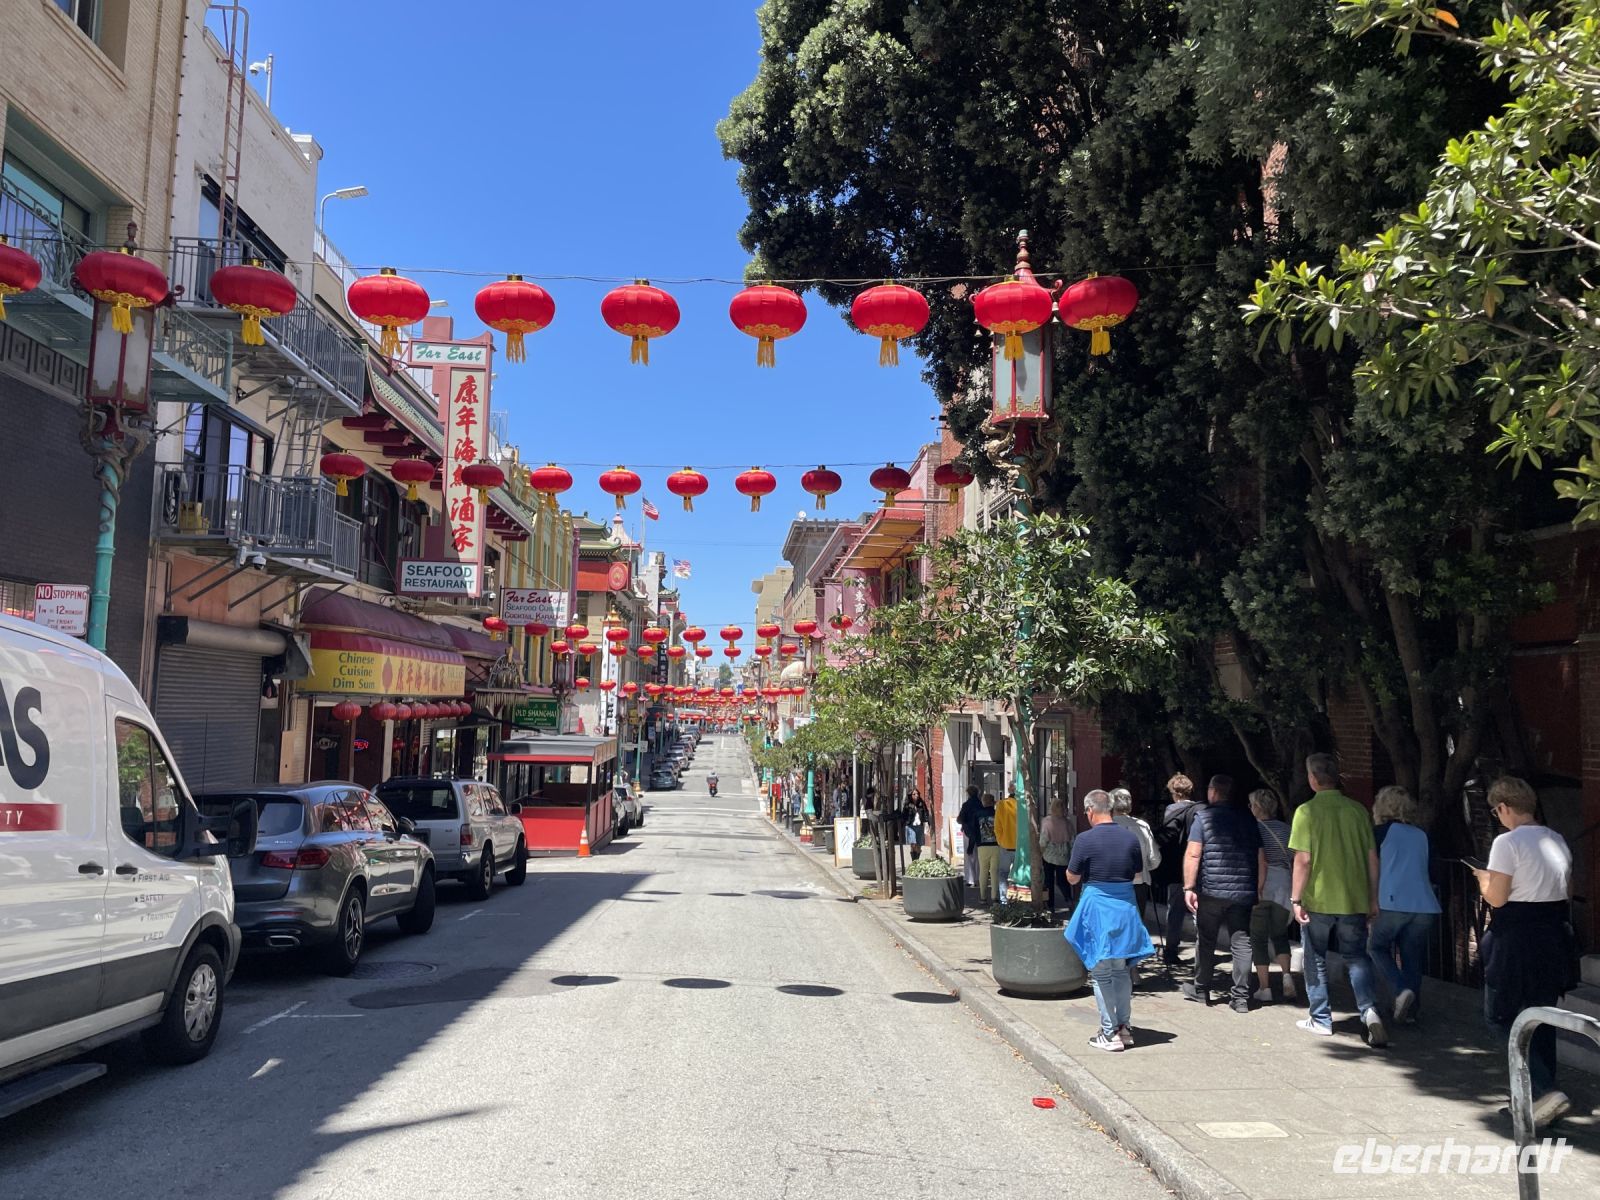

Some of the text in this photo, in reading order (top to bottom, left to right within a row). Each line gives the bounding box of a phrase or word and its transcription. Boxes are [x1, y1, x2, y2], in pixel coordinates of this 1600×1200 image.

[416, 343, 482, 361] Far East
[406, 564, 472, 578] SEAFOOD
[404, 577, 474, 589] RESTAURANT
[37, 585, 87, 600] NO STOPPING
[505, 590, 525, 603] Far
[526, 591, 553, 604] East
[506, 602, 565, 613] SEAFOOD CUISINE
[338, 652, 375, 665] Chinese
[339, 665, 373, 677] Cuisine
[332, 677, 375, 690] Dim Sum
[515, 709, 557, 718] OLD SHANGHAI
[353, 741, 369, 750] PEN
[138, 873, 170, 881] FIRST AID
[139, 893, 165, 903] SAFETY
